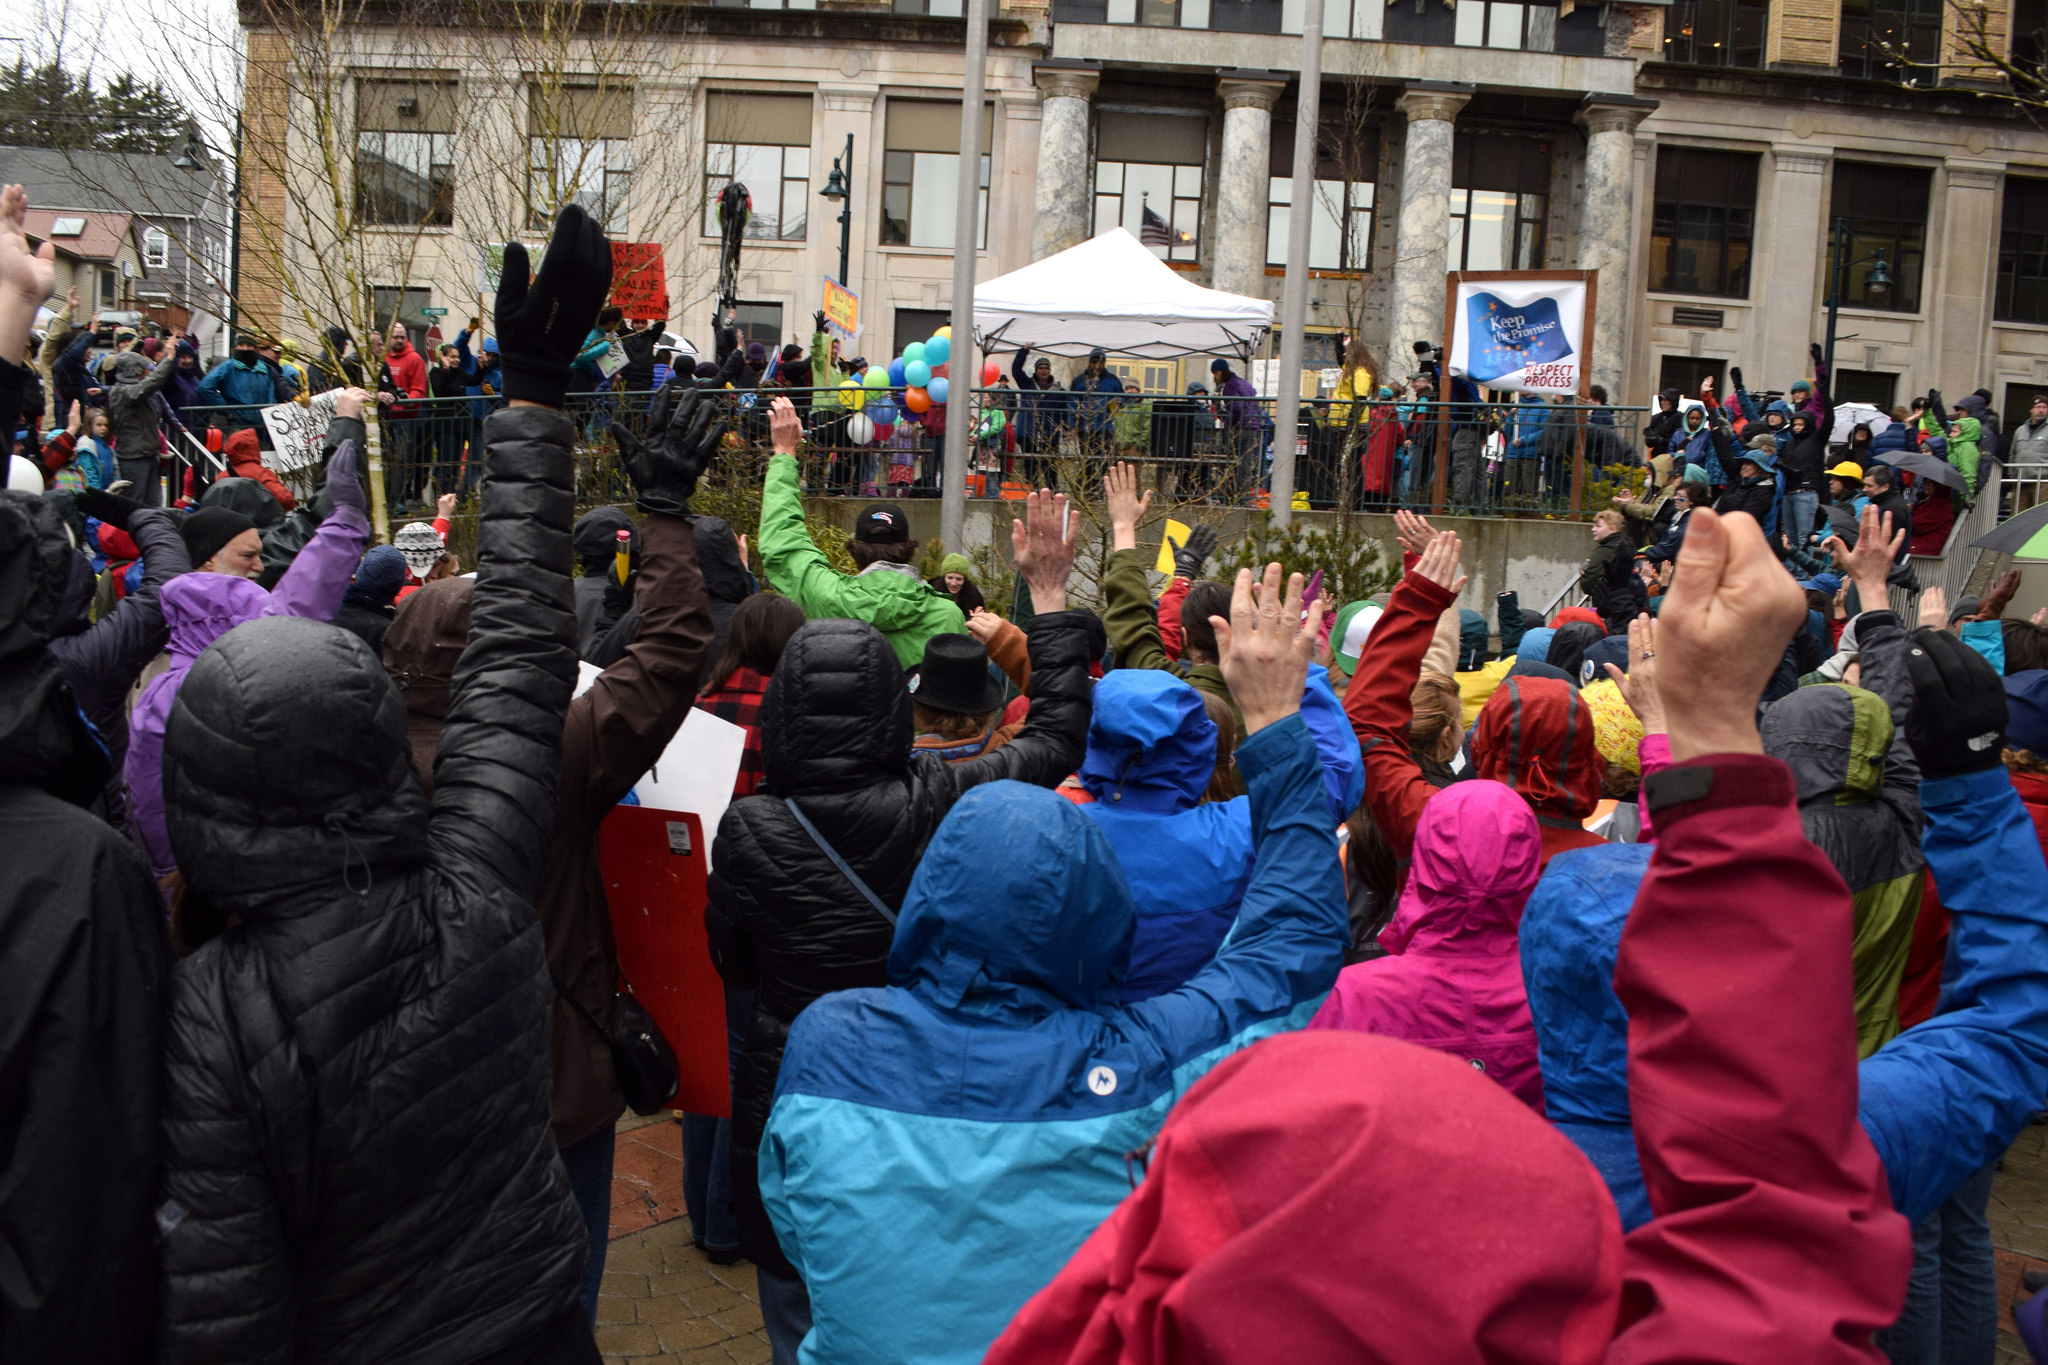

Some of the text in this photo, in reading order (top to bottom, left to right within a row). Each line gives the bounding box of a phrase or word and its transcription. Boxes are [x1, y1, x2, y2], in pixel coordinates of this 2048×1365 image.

[614, 279, 659, 291] ALUE
[1490, 315, 1525, 331] Keep
[1493, 321, 1556, 343] the Promise
[425, 336, 443, 350] STOP
[1525, 364, 1574, 376] RESPECT
[1523, 376, 1572, 387] PROCESS
